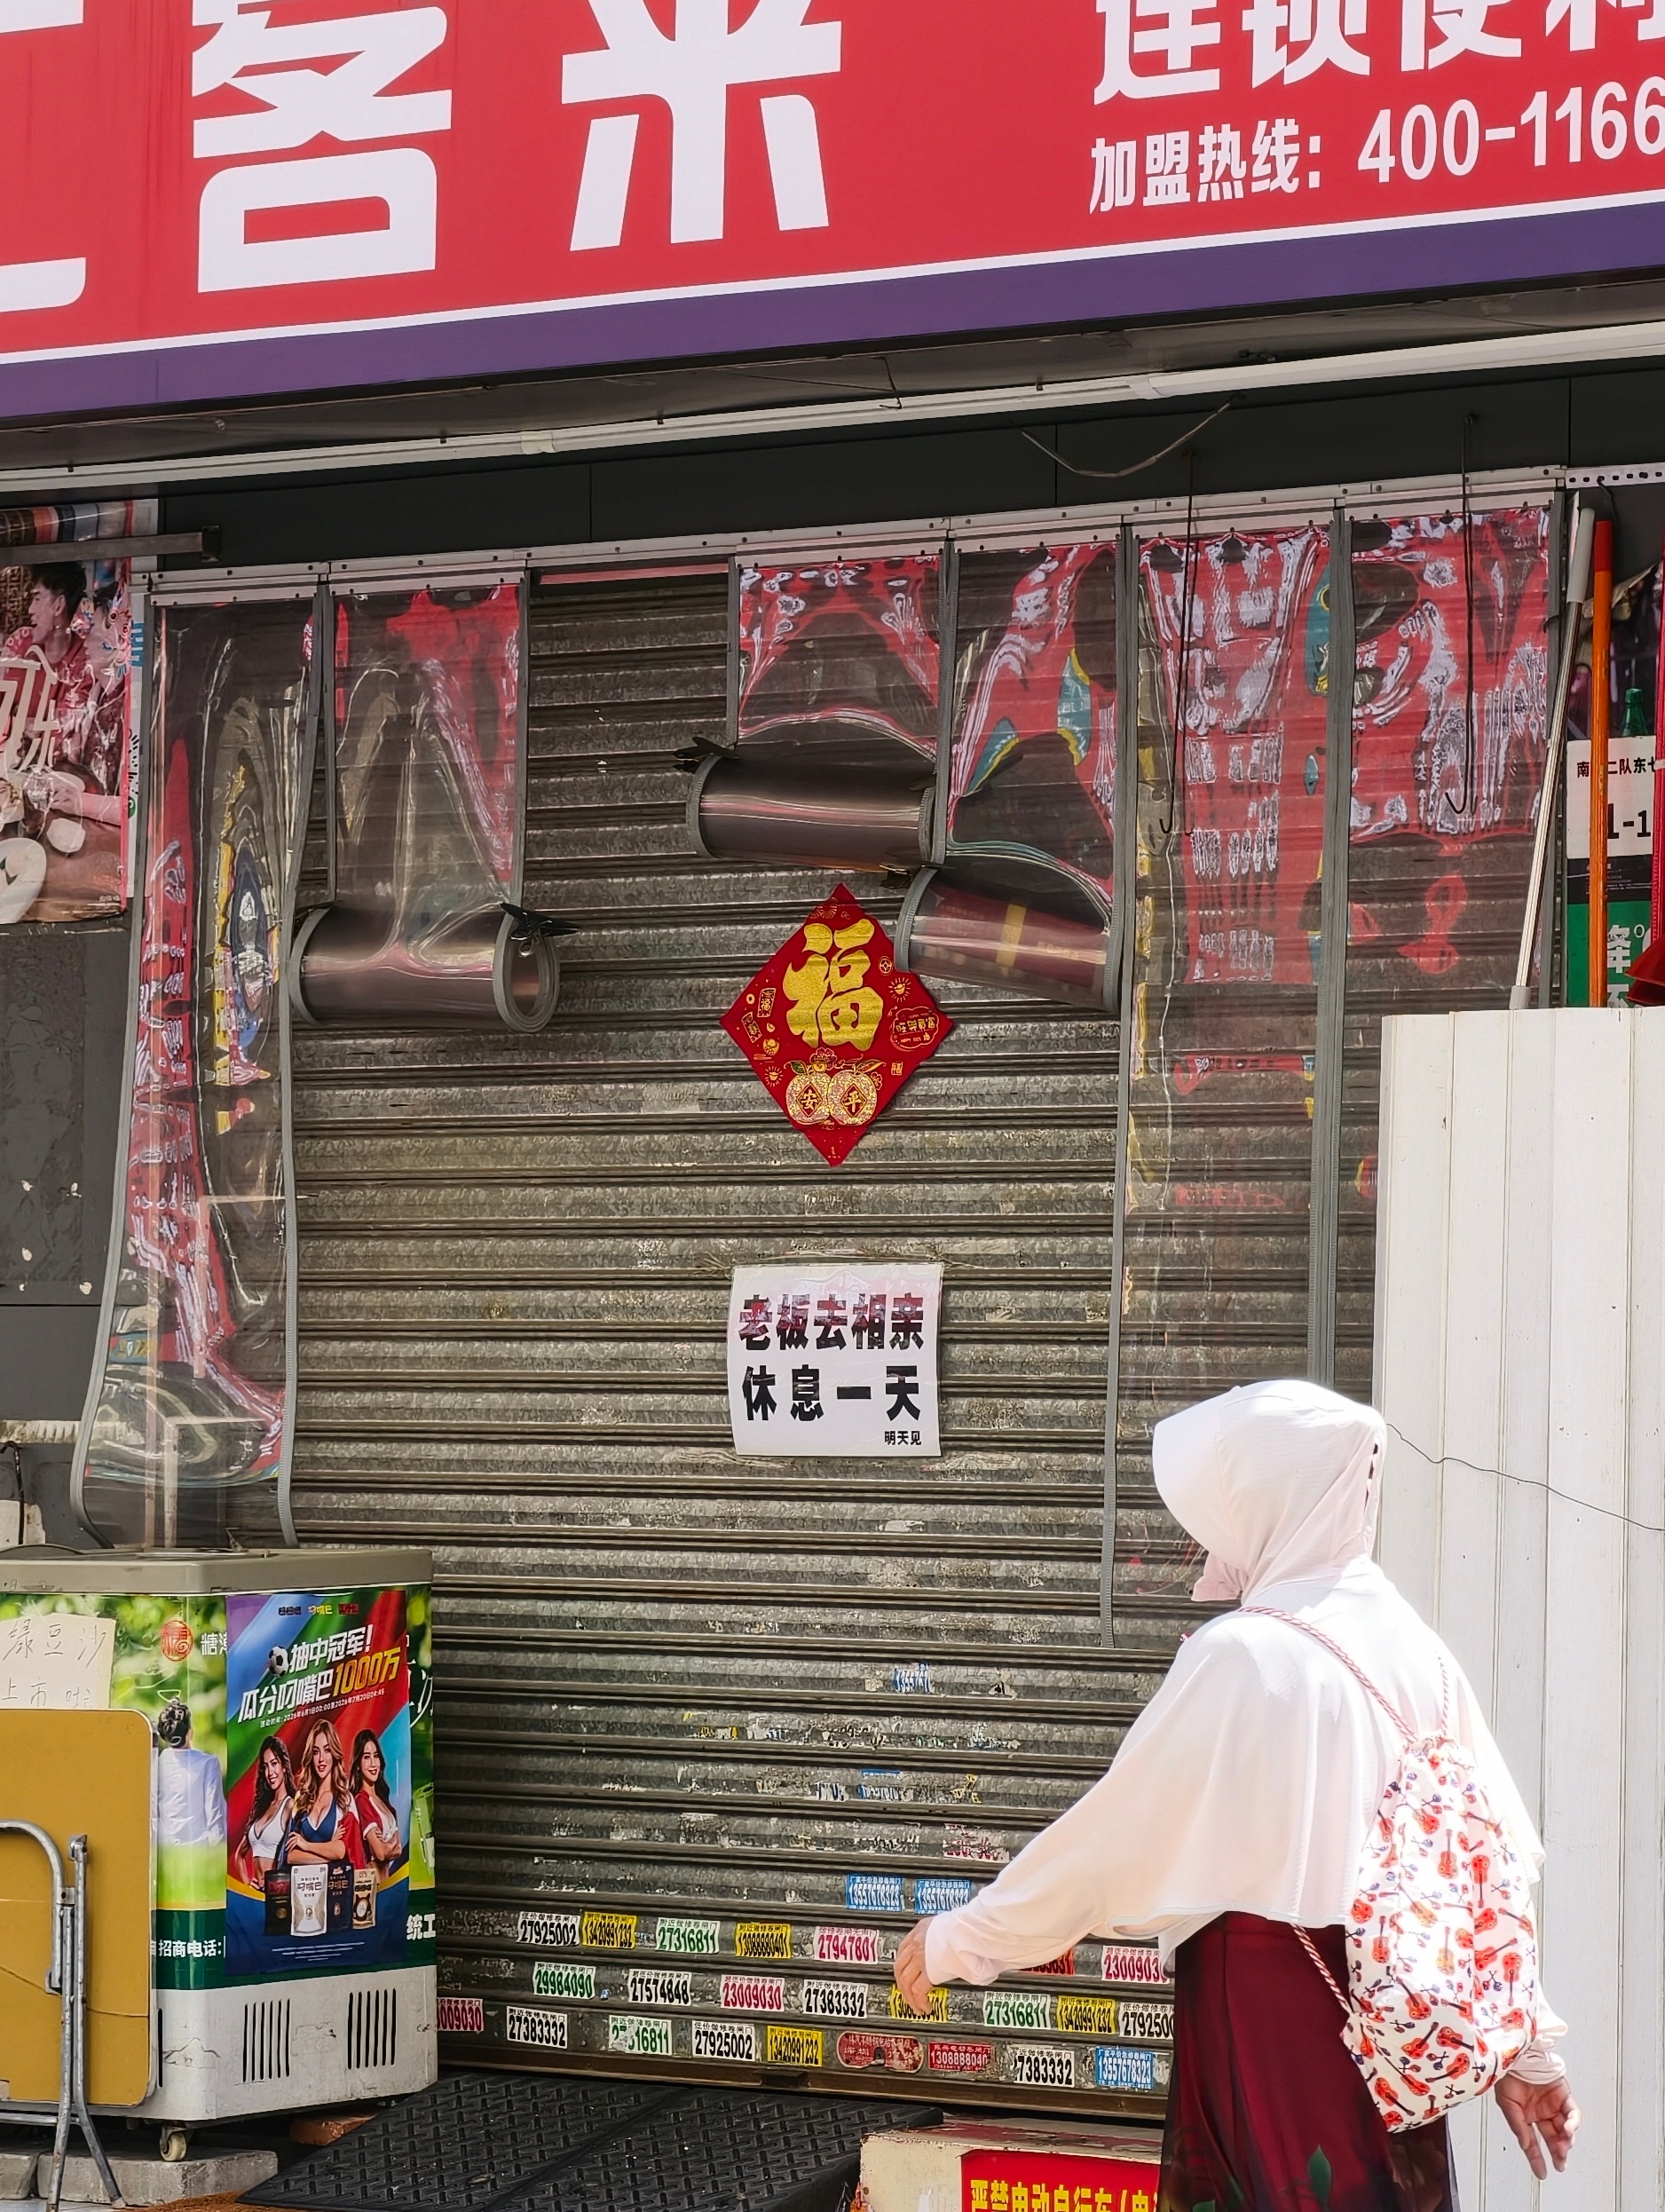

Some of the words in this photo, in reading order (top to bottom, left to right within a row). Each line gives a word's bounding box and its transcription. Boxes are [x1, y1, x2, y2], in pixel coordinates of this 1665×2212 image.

[1358, 76, 1665, 183] 400-1166
[783, 919, 884, 1051] 福
[738, 1292, 924, 1350] 老板去相亲
[742, 1364, 921, 1421] 休息一天
[884, 1431, 922, 1445] 明天见
[4, 1618, 107, 1669] 绿豆沙
[520, 1920, 576, 1945] 27925002
[584, 1922, 633, 1947] 13420991232
[659, 1926, 716, 1952] 27316811
[818, 1934, 876, 1963] 27947801
[535, 1970, 593, 1998] 29984090
[630, 1977, 689, 2005] 27574848
[723, 1983, 781, 2011] 23009030
[805, 1988, 864, 2018] 27383332
[985, 2001, 1047, 2027] 27316811
[509, 2015, 565, 2047] 27383332
[1059, 2004, 1111, 2034] 13420991232
[695, 2030, 753, 2059] 27925002
[769, 2035, 818, 2066] 13420991232
[1099, 2056, 1151, 2084] 13557678323
